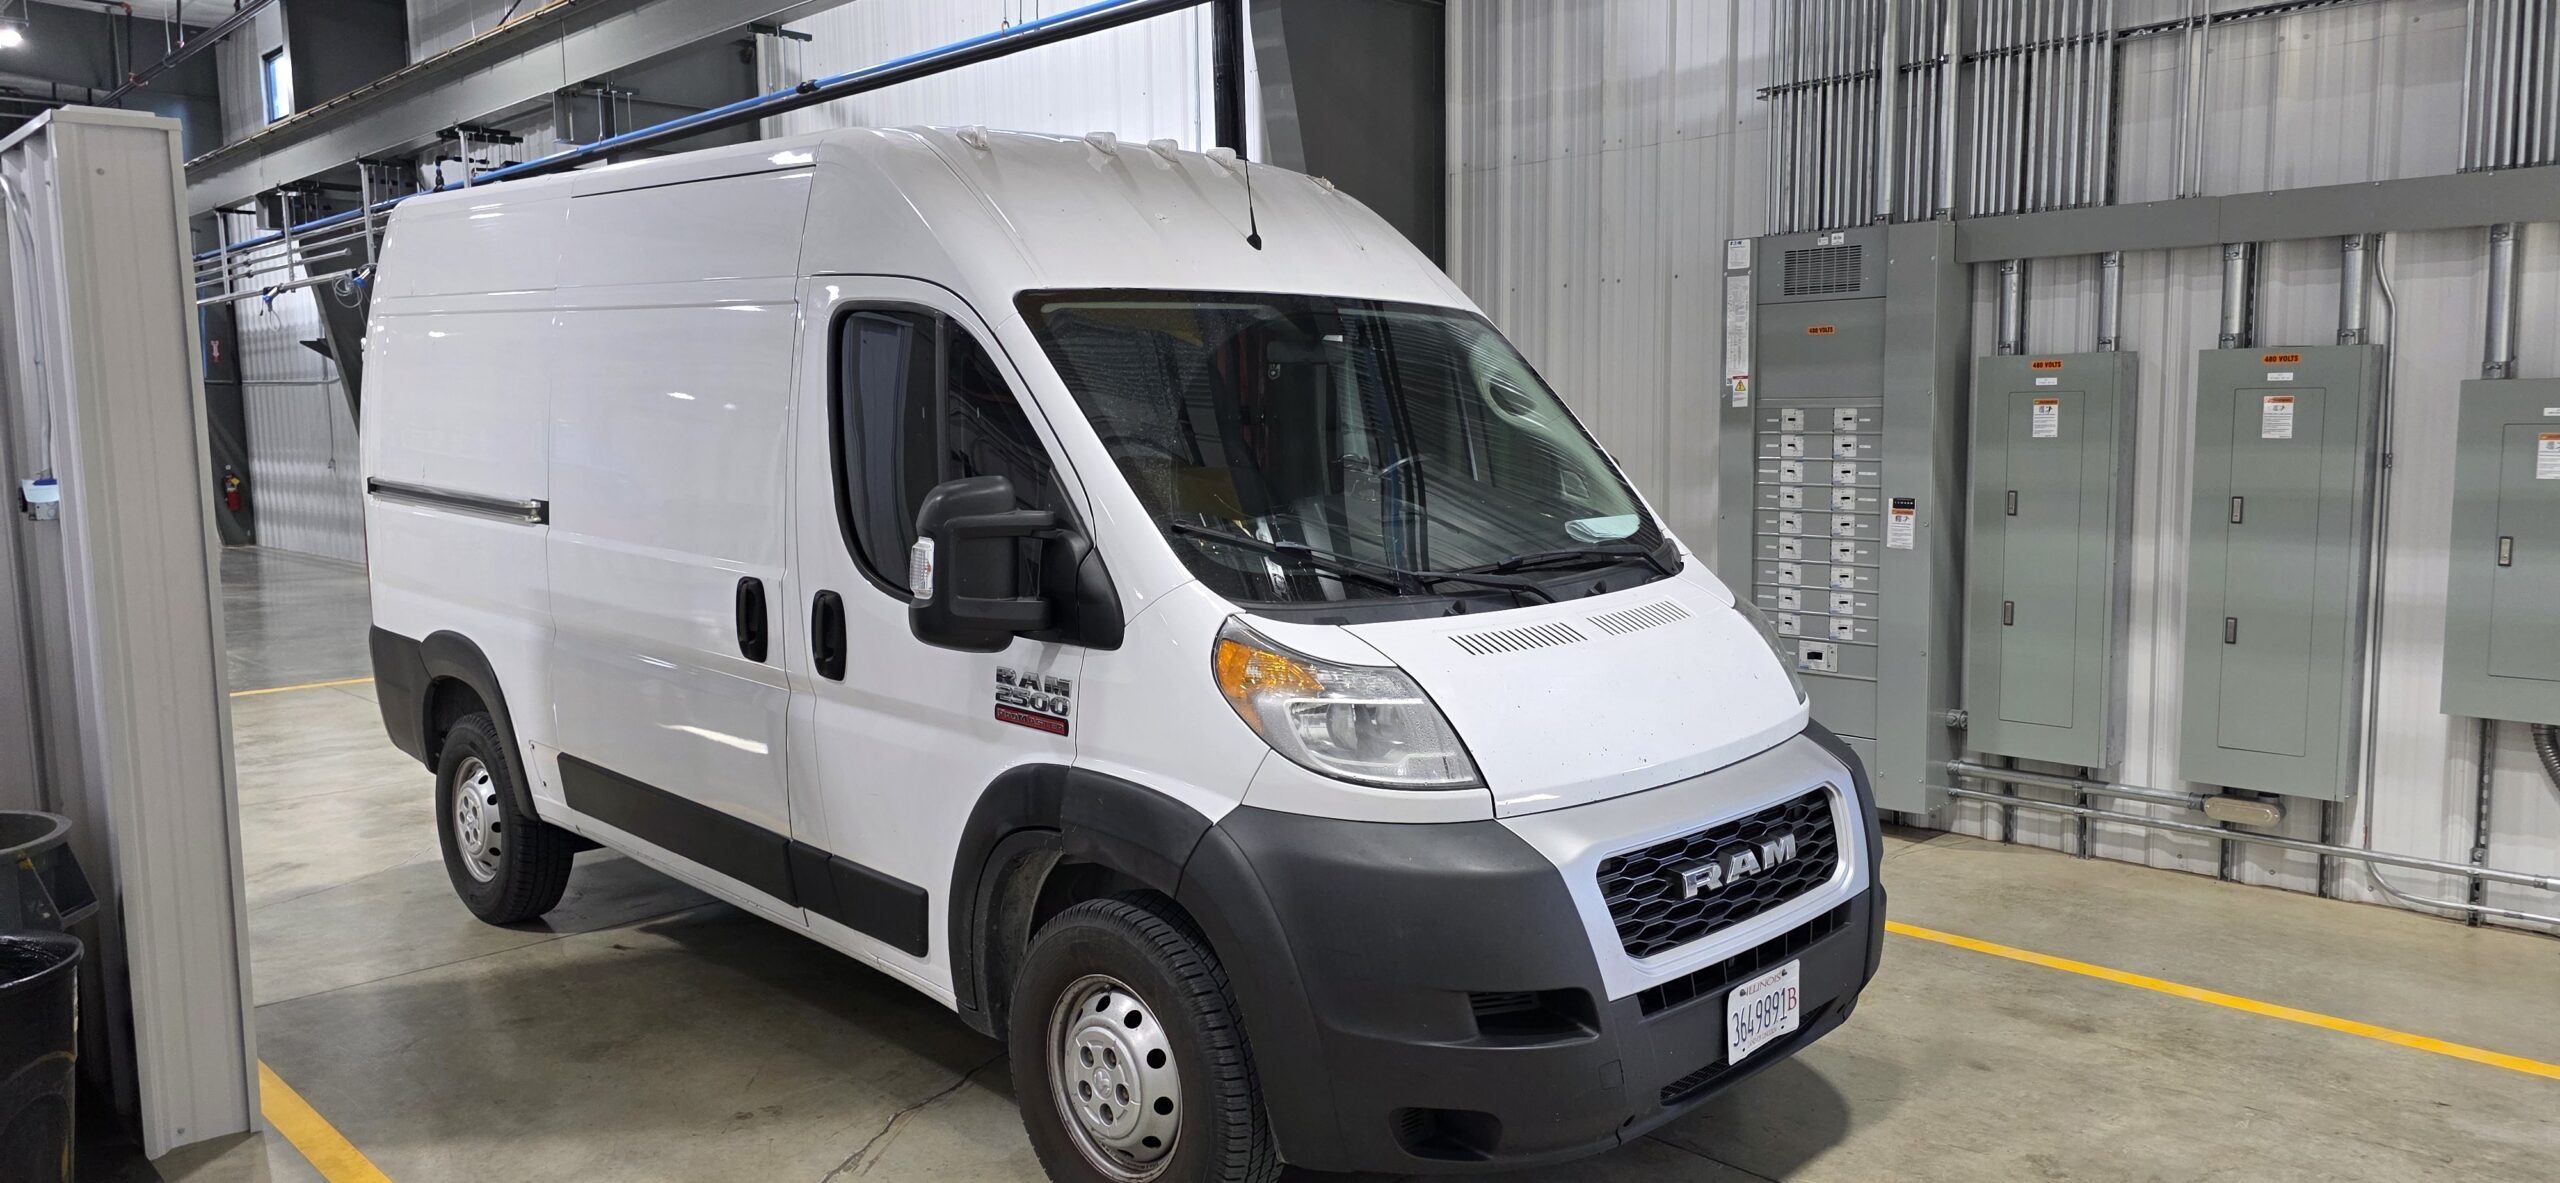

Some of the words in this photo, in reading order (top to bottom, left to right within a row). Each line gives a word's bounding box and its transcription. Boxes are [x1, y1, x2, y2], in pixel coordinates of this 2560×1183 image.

[2032, 361, 2043, 369] 480
[2264, 355, 2277, 363] 480
[2279, 354, 2298, 362] VOLTS
[996, 666, 1072, 698] RAM
[996, 684, 1071, 717] 2500
[1682, 832, 1797, 899] RAM
[1746, 971, 1782, 996] ILLINOIS
